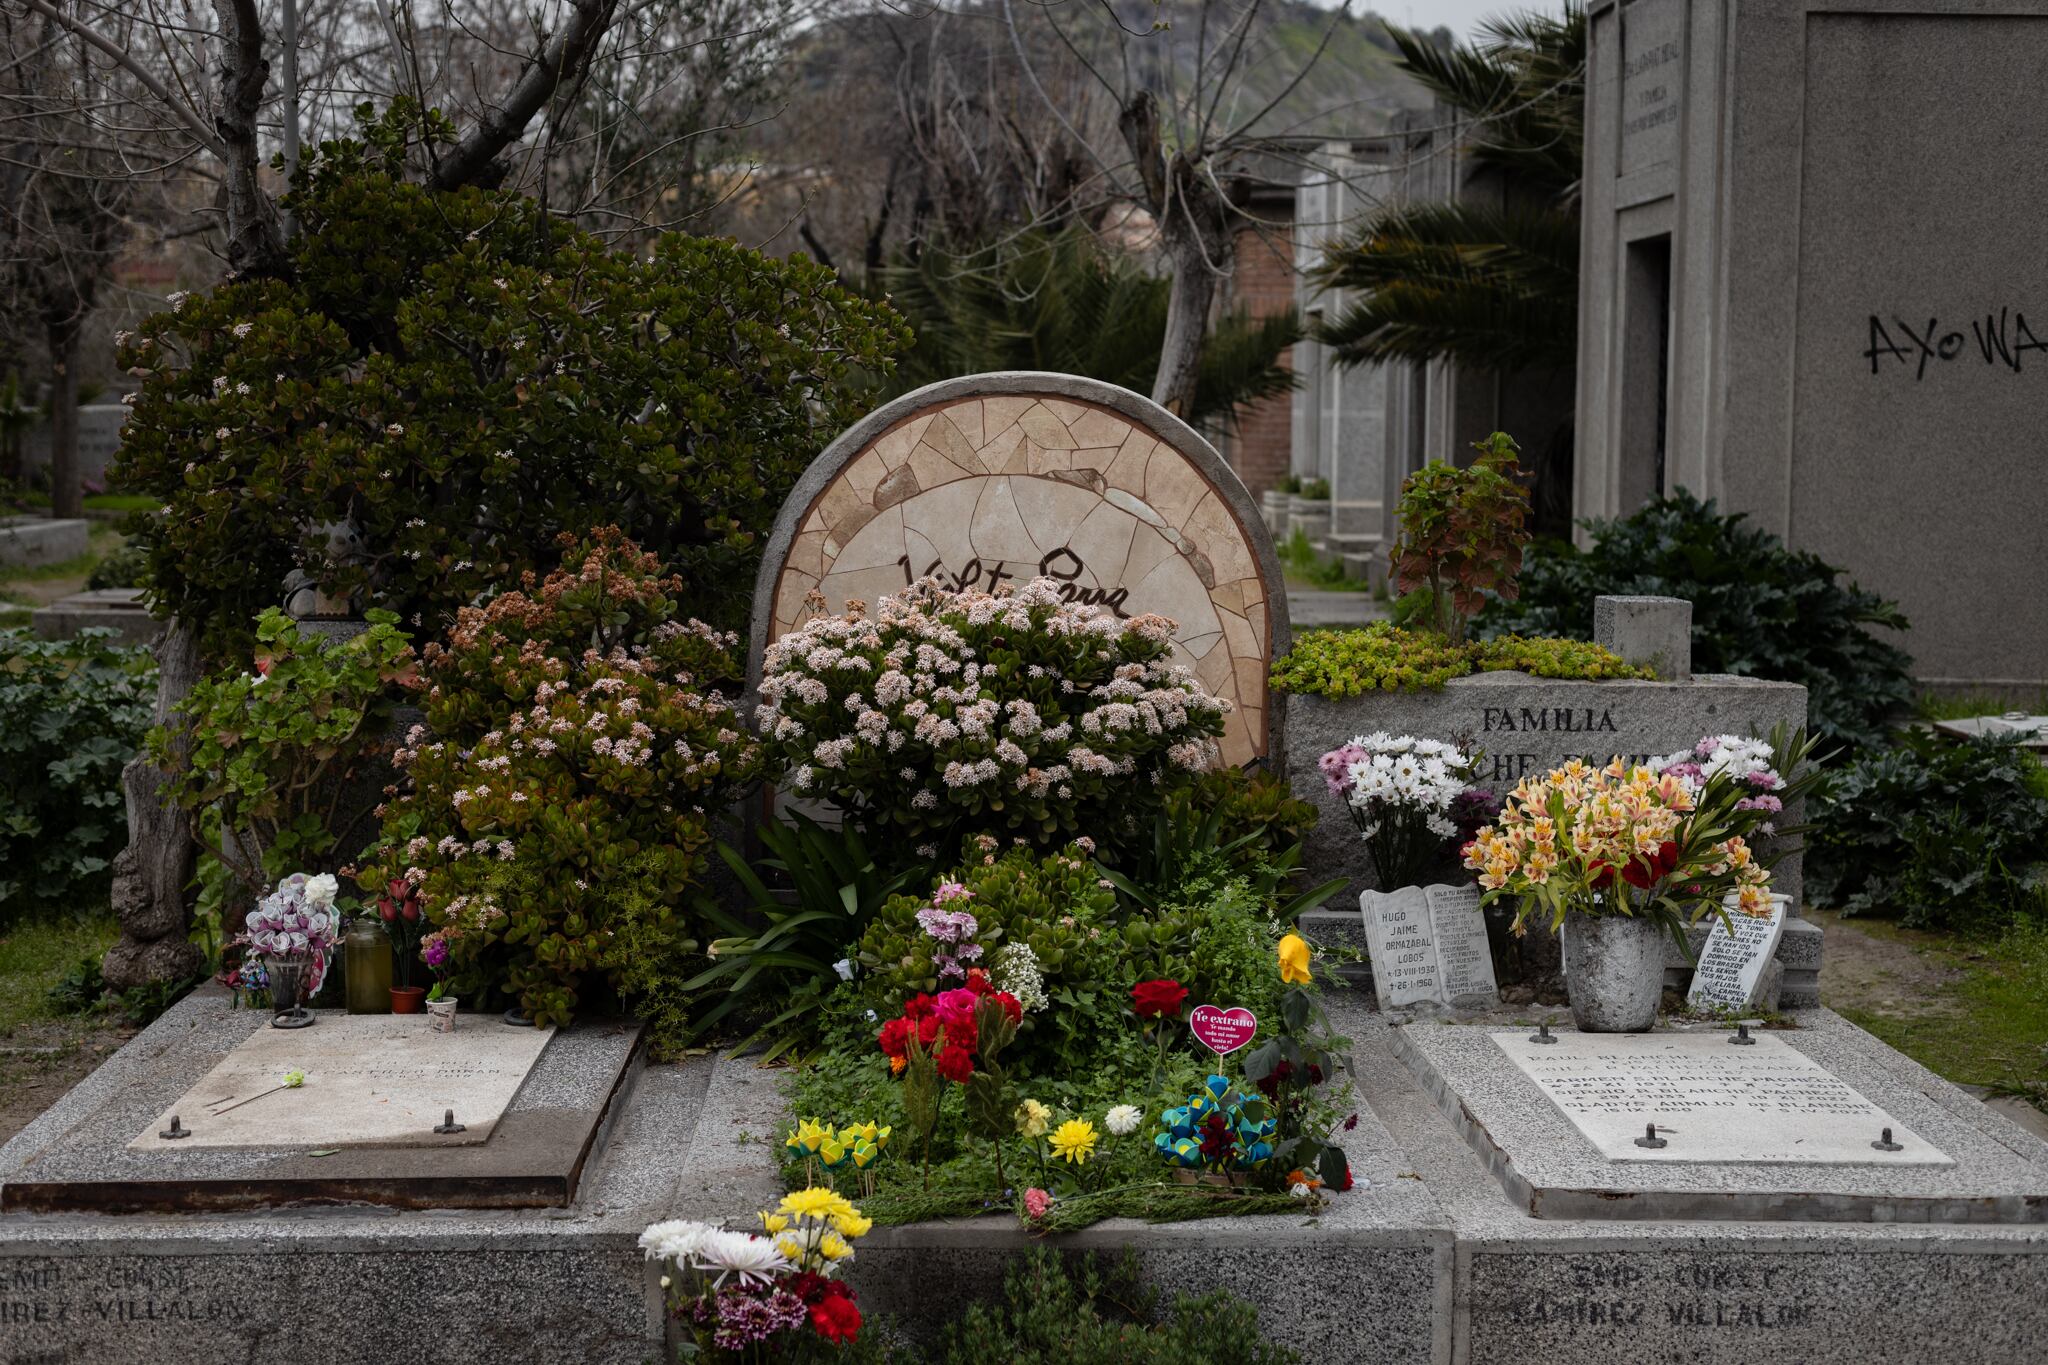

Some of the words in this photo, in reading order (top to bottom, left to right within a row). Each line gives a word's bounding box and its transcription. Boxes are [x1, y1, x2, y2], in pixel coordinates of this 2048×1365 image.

[1483, 707, 1619, 732] FAMILIA
[1382, 911, 1406, 922] HUGO
[1390, 924, 1418, 936] JAIME
[1385, 938, 1431, 951] ORMAZABAL
[1722, 934, 1751, 944] PADRES
[1722, 941, 1737, 949] HAN
[1738, 943, 1751, 951] IDO
[1707, 953, 1737, 962] DORMIDO
[1712, 946, 1731, 954] SOLO
[1742, 950, 1758, 958] HAN
[1398, 952, 1424, 964] LOBOS
[1700, 965, 1714, 973] DEL
[1702, 959, 1716, 967] LOS
[1716, 960, 1745, 970] BRAZOS
[1700, 971, 1714, 979] TUS
[1729, 996, 1744, 1004] ANA
[1194, 1010, 1208, 1023] Te
[1777, 1102, 1873, 1110] BLANCHE
